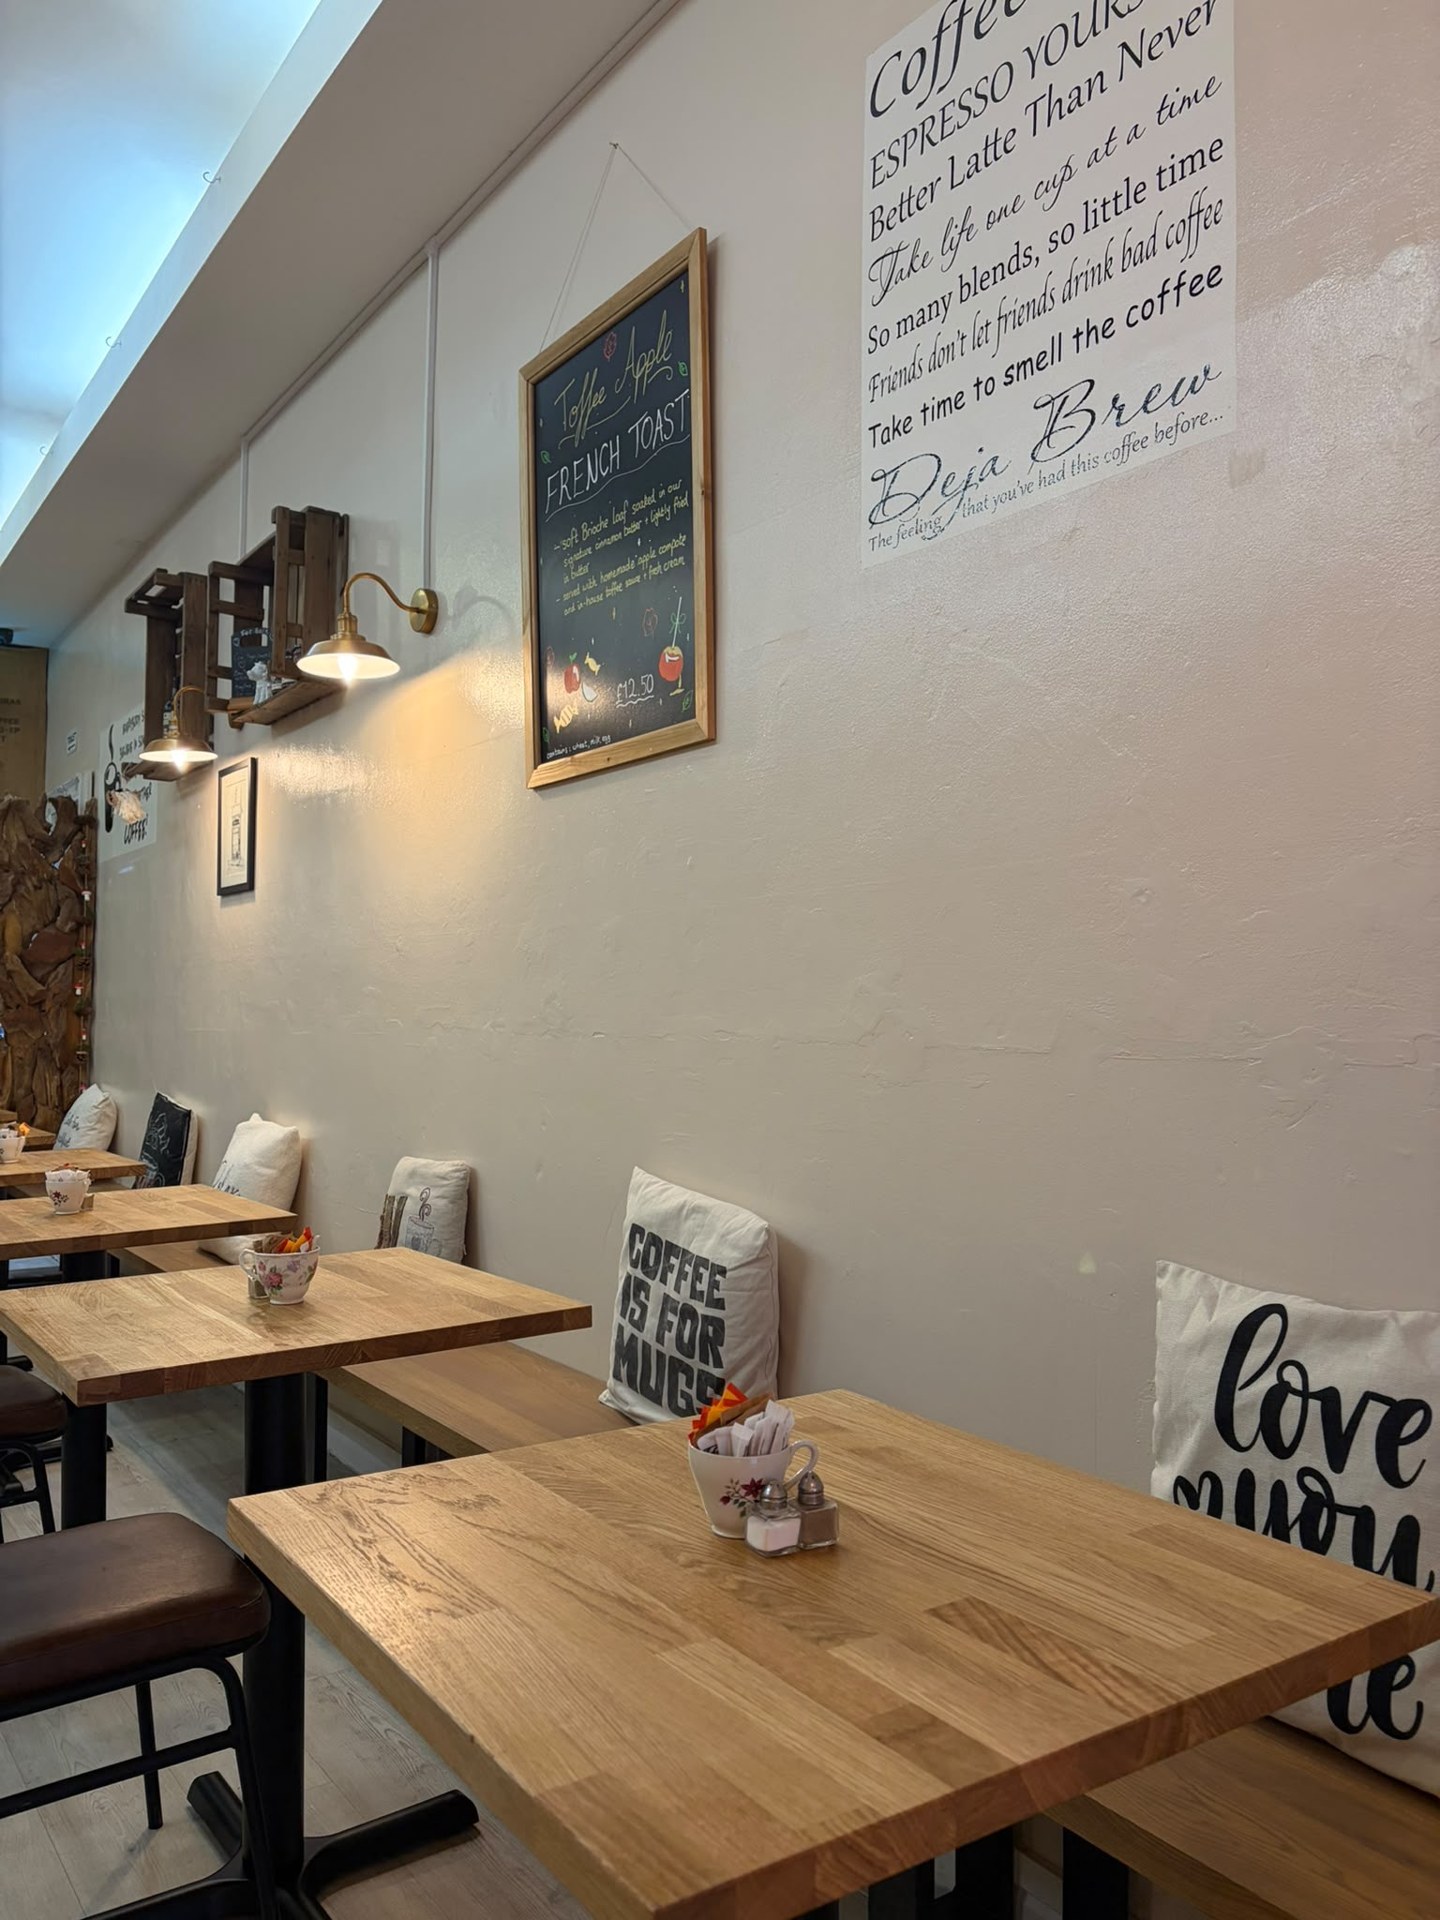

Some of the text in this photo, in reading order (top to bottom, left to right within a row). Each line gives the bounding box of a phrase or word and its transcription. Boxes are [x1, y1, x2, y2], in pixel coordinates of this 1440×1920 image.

[869, 0, 1216, 242] Better Latte Than Never
[870, 61, 1013, 190] ESPRESSO
[868, 75, 1223, 307] Take life one cup at a time
[868, 138, 1224, 354] So many blends, so little time
[868, 186, 1223, 403] Friends don't let friends drink bad coffee
[868, 264, 1223, 448] Take time to smell the coffee
[554, 310, 673, 447] Toffee Apple
[545, 389, 689, 513] FRENCH TOAST
[562, 527, 579, 550] soft
[582, 516, 608, 541] Brioche
[613, 500, 628, 525] loaf
[632, 488, 656, 515] soaked
[659, 483, 665, 498] in
[667, 479, 682, 493] our
[673, 490, 689, 515] fried
[868, 363, 1222, 540] Deja Brew
[869, 411, 1223, 551] The feeling that you've had this coffee before...
[637, 546, 656, 570] apple
[616, 674, 654, 704] £12.50
[620, 1272, 726, 1369] IS FOR
[628, 1223, 727, 1311] COFFEE
[1214, 1303, 1433, 1489] love
